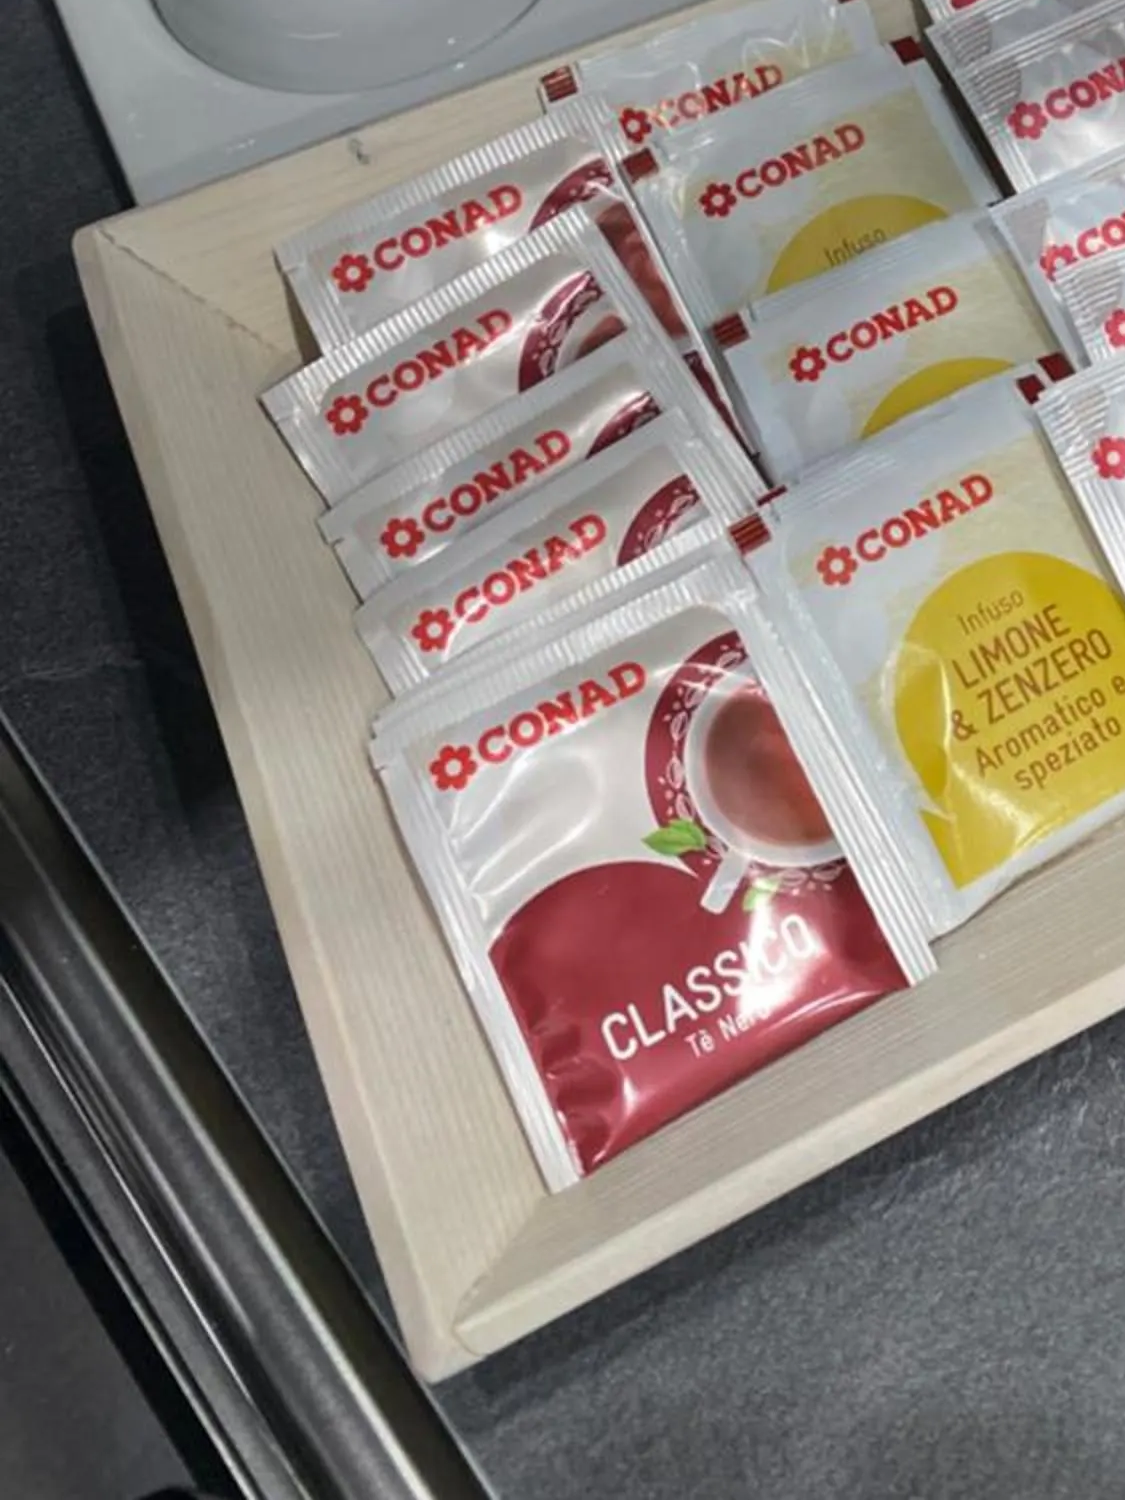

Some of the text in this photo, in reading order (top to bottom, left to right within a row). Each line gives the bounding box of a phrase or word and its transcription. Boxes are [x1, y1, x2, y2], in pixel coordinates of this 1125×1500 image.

[652, 64, 783, 128] CONAD
[735, 124, 865, 198] CONAD
[373, 185, 523, 272] CONAD
[823, 227, 888, 269] Infuso
[366, 308, 513, 407] CONAD
[826, 286, 958, 363] CONAD
[422, 429, 572, 533] CONAD
[856, 473, 994, 562] CONAD
[453, 513, 608, 623] CONAD
[956, 587, 1024, 637] Infuso
[950, 603, 1072, 691] LIMONE
[950, 628, 1113, 742] & ZENZERO
[478, 661, 647, 764] CONAD
[976, 689, 1107, 778] Aromatico
[1014, 713, 1123, 791] speziato
[600, 913, 816, 1061] CLASSICO
